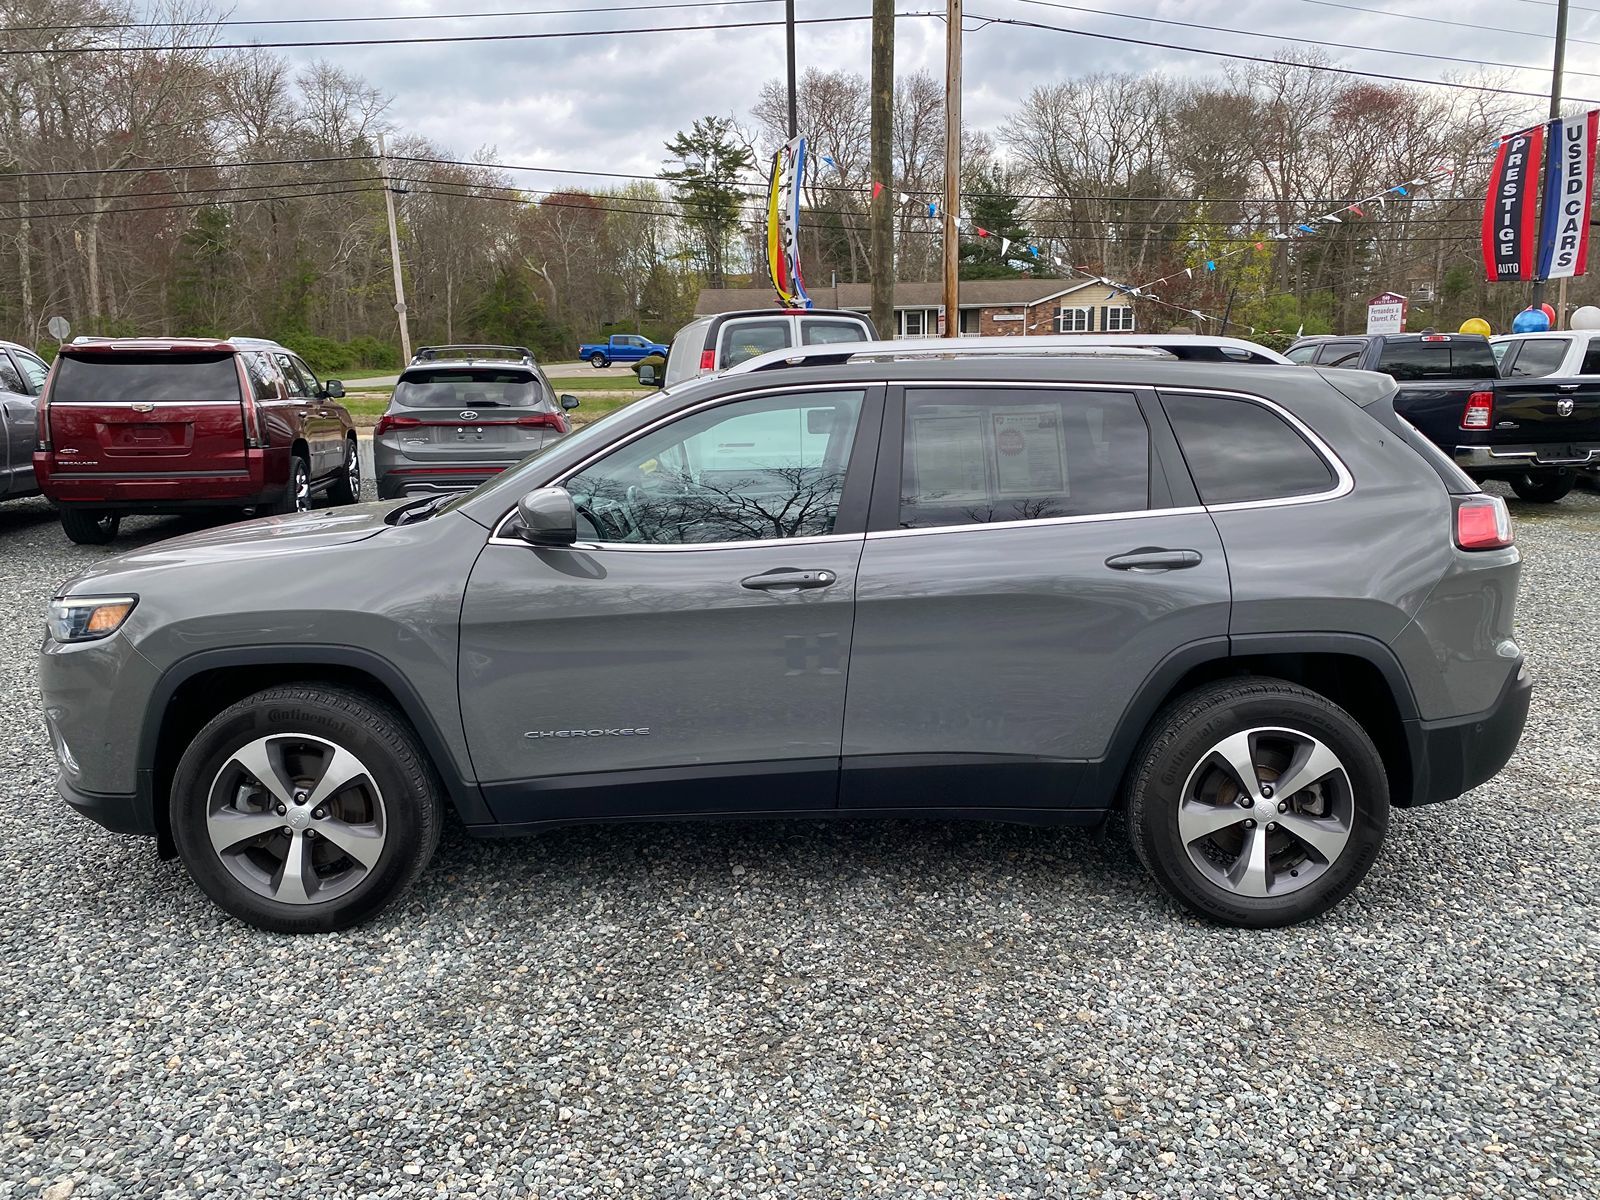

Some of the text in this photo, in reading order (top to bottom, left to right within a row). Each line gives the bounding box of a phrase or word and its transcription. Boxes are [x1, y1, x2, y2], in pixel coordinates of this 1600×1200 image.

[1499, 138, 1526, 255] PRESTIGE
[1557, 124, 1583, 267] USED CARS
[1498, 262, 1519, 274] AUTO
[1371, 306, 1394, 315] Fernandes
[523, 727, 650, 739] CHEROKEE
